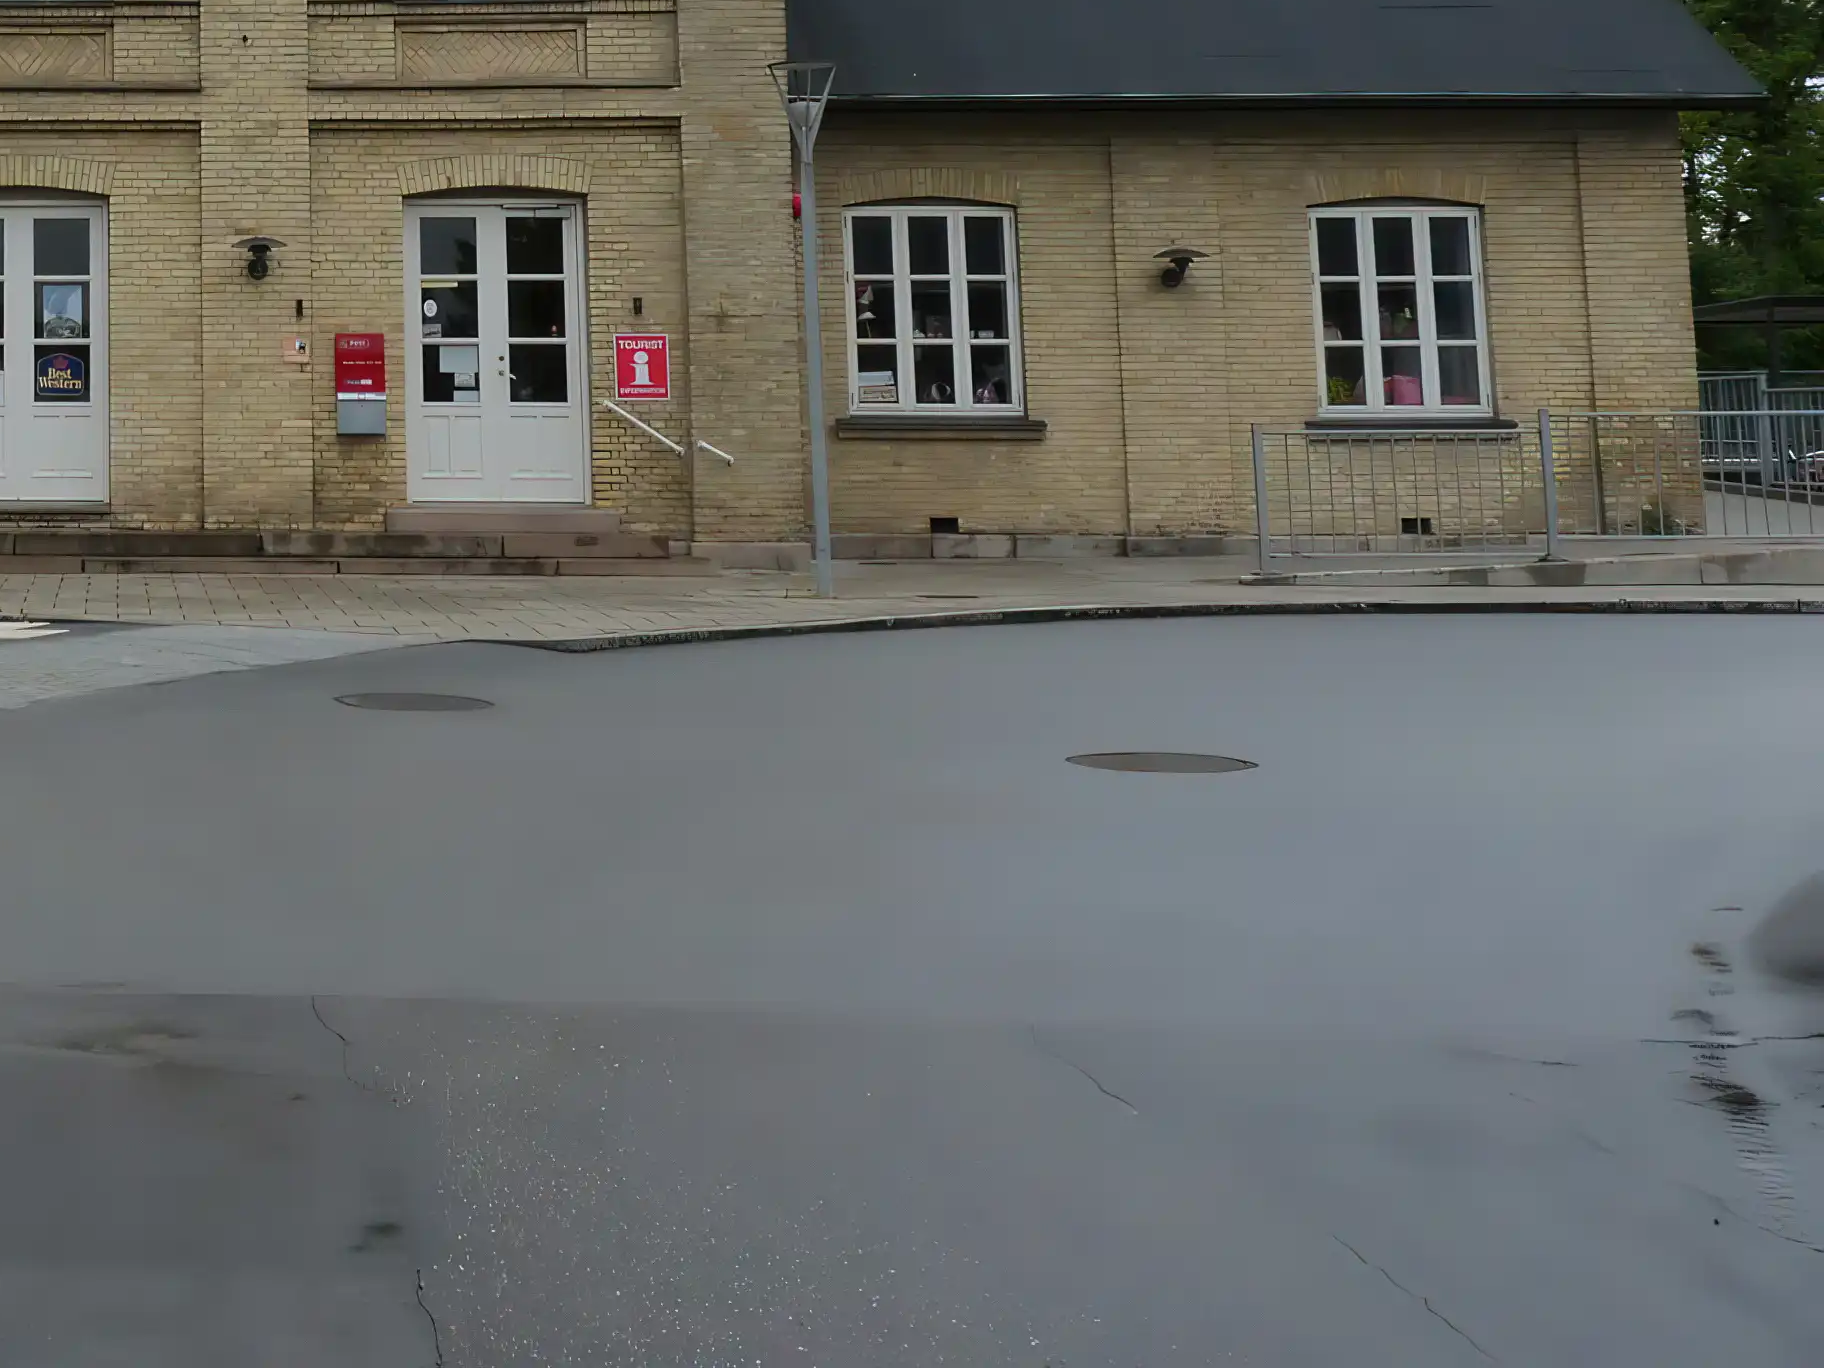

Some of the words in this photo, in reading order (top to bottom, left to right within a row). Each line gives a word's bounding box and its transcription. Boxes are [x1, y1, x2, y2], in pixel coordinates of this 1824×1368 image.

[618, 339, 664, 350] TOURIST
[47, 367, 72, 380] Best
[39, 376, 82, 389] Western
